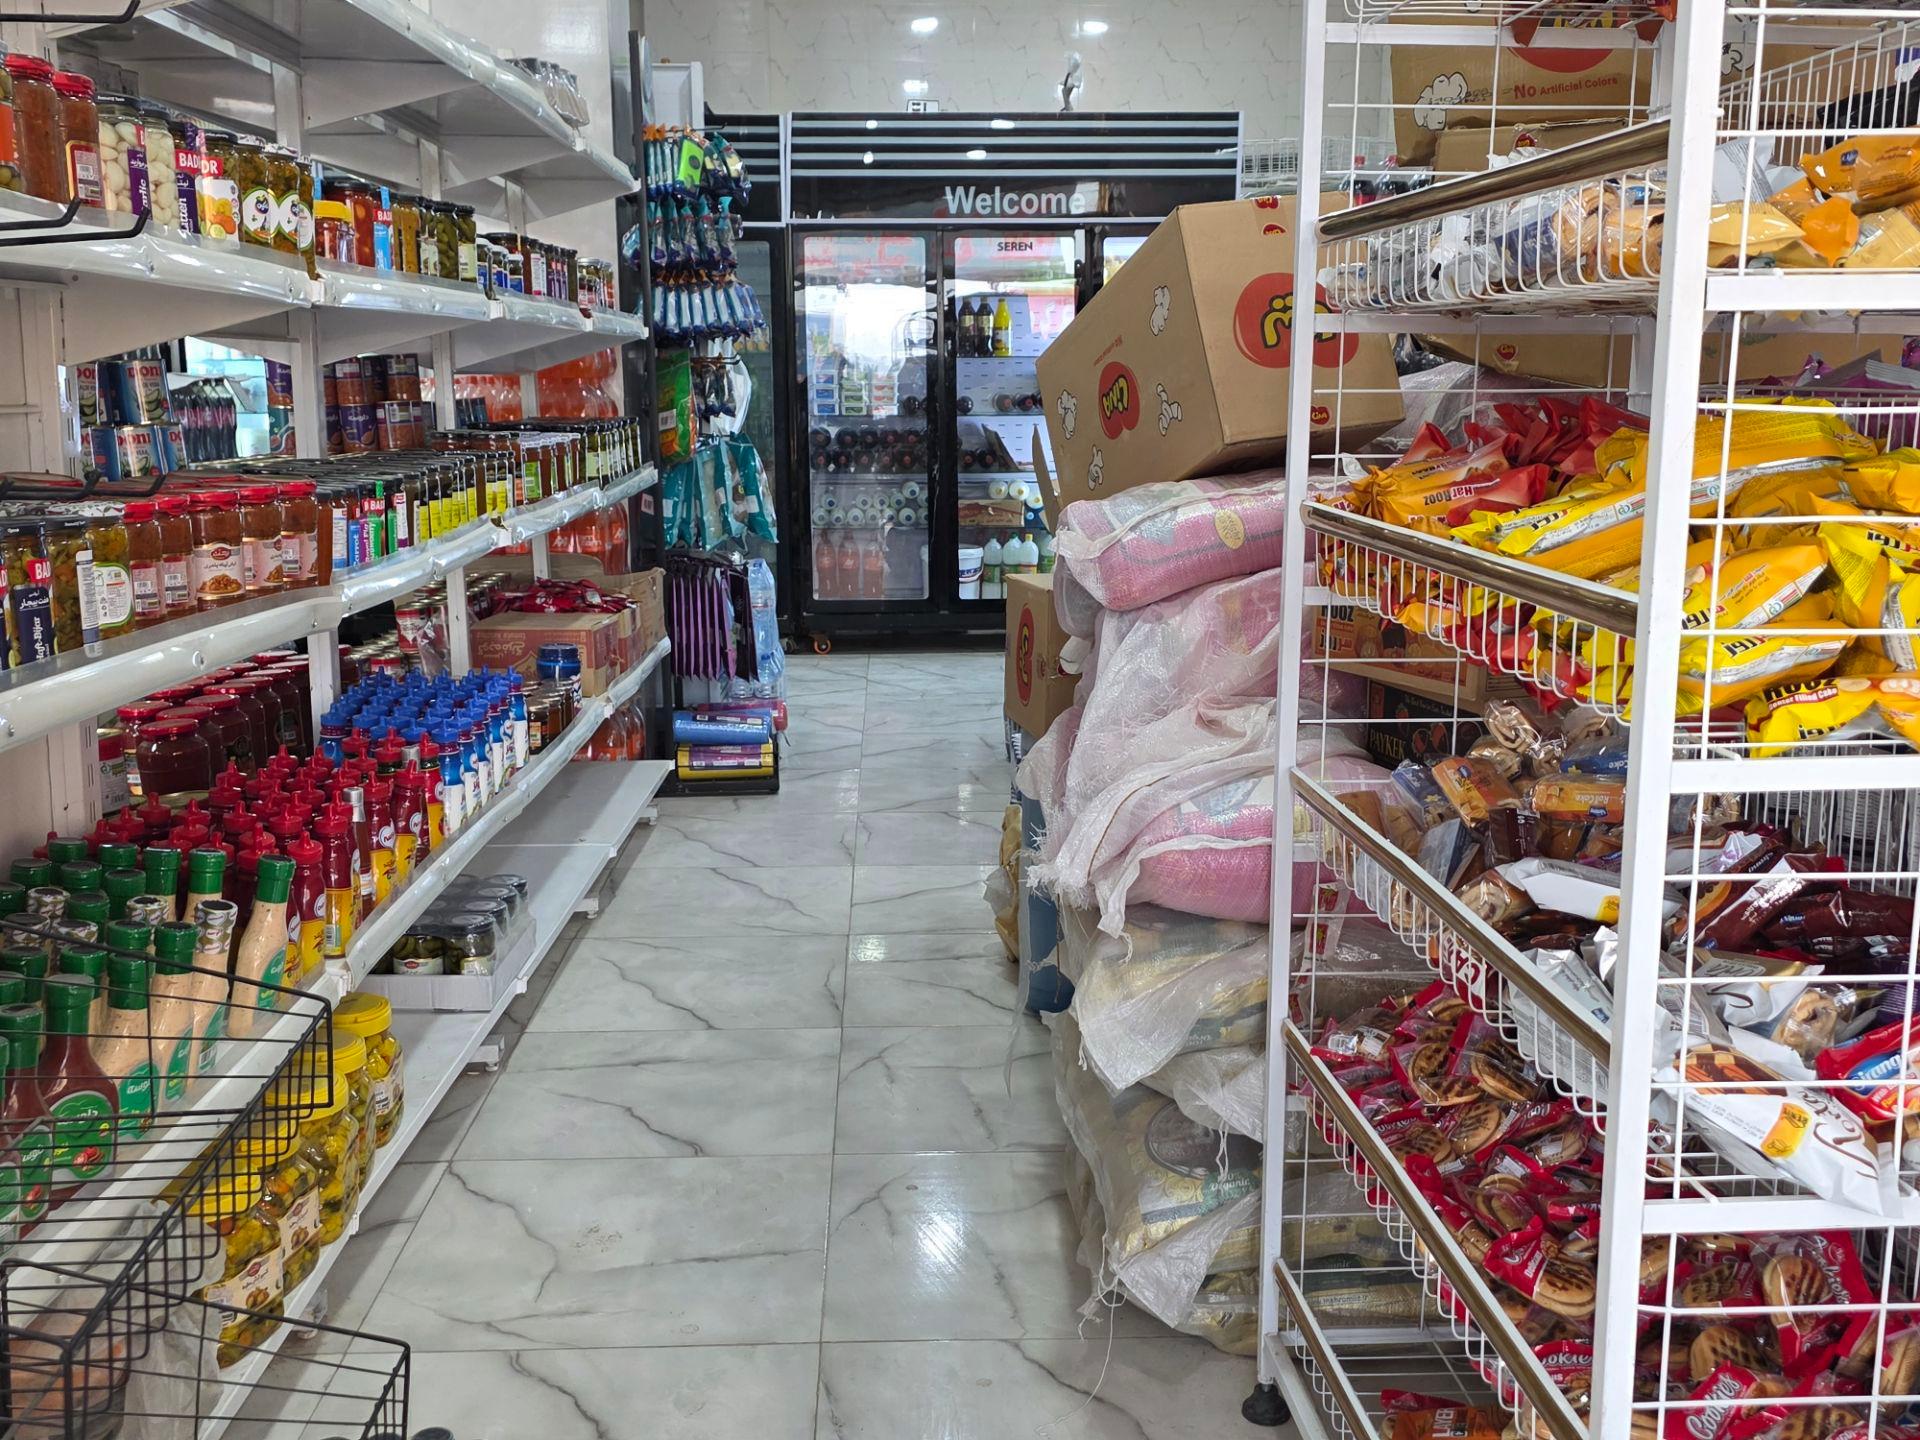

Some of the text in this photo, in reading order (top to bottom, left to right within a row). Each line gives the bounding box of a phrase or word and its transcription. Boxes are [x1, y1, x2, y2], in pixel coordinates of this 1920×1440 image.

[1513, 76, 1618, 99] No Artificial Colors
[945, 185, 1086, 216] Welcome
[997, 241, 1033, 252] SEREN
[1794, 691, 1818, 703] Filled
[1818, 687, 1838, 699] Cake
[1851, 1054, 1902, 1091] Sirang
[1432, 1407, 1455, 1438] LAYER
